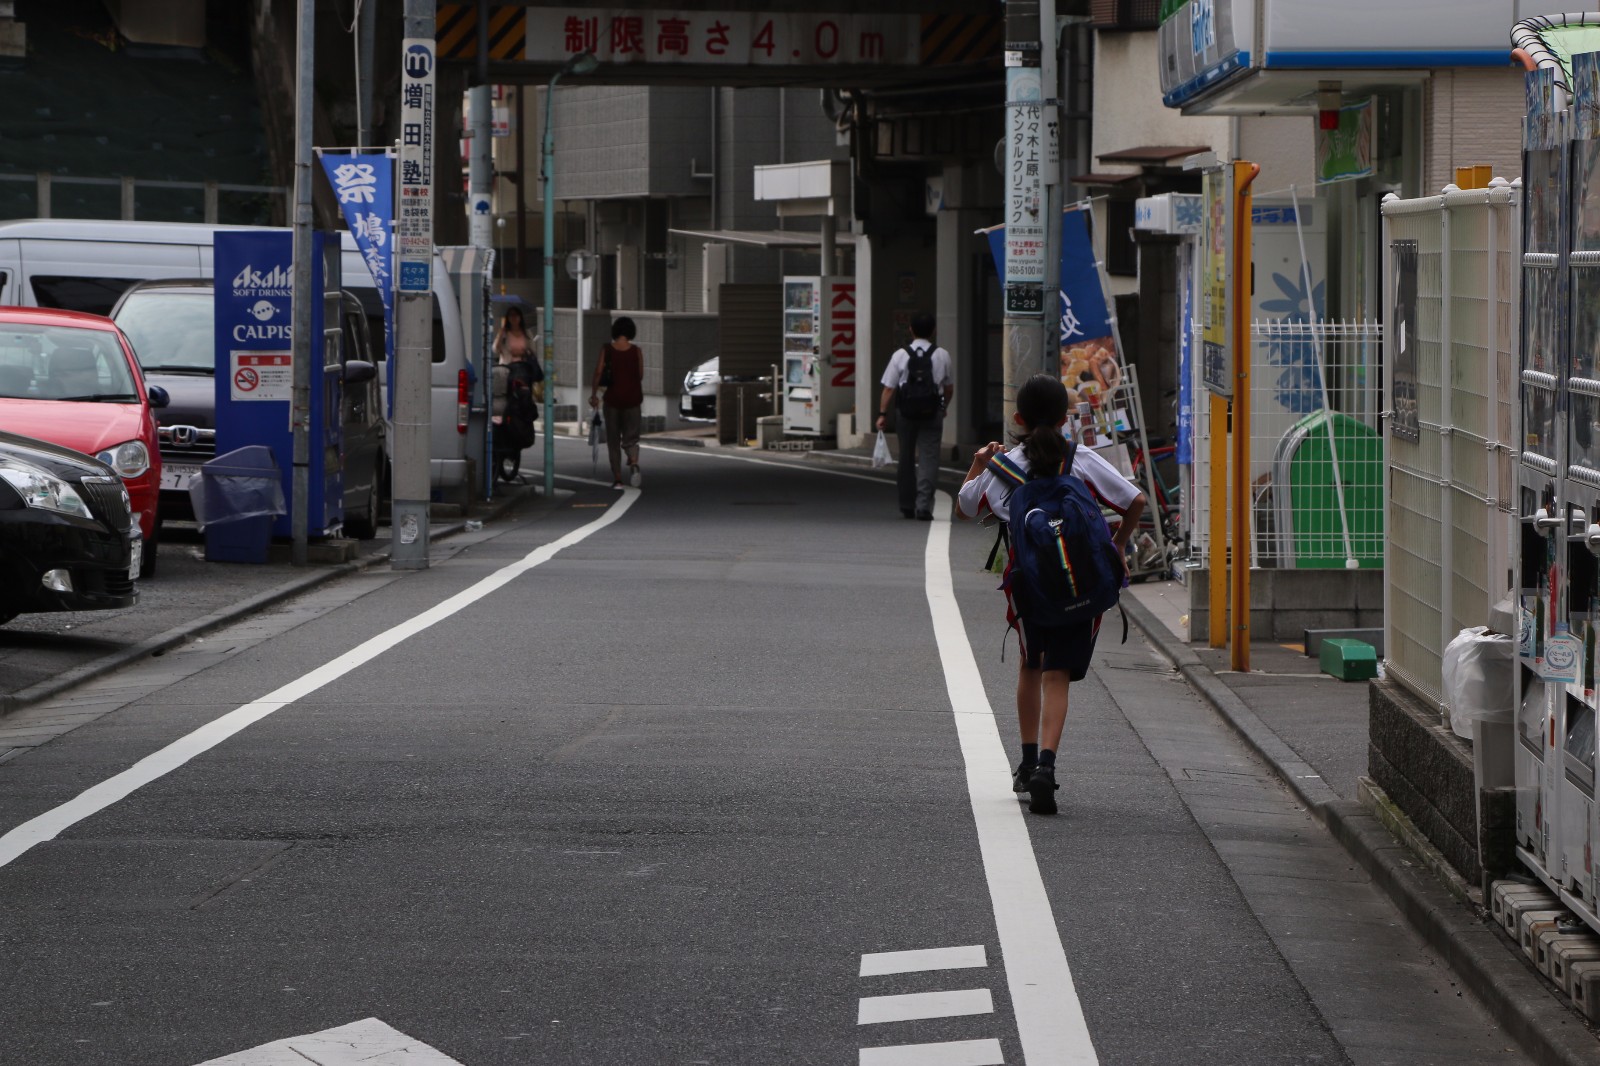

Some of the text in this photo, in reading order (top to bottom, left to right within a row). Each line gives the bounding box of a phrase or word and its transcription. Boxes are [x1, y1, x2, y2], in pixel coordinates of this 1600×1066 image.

[403, 83, 423, 185] 増田塾
[1026, 105, 1041, 176] 代々木上原
[332, 163, 377, 204] 祭
[1012, 105, 1025, 223] メンタルクリニック
[403, 207, 428, 217] 池袋校
[232, 289, 293, 297] SOFT DRINKS
[1010, 299, 1037, 308] 2-29
[232, 324, 293, 342] CALPIS
[831, 284, 856, 388] KIRIN
